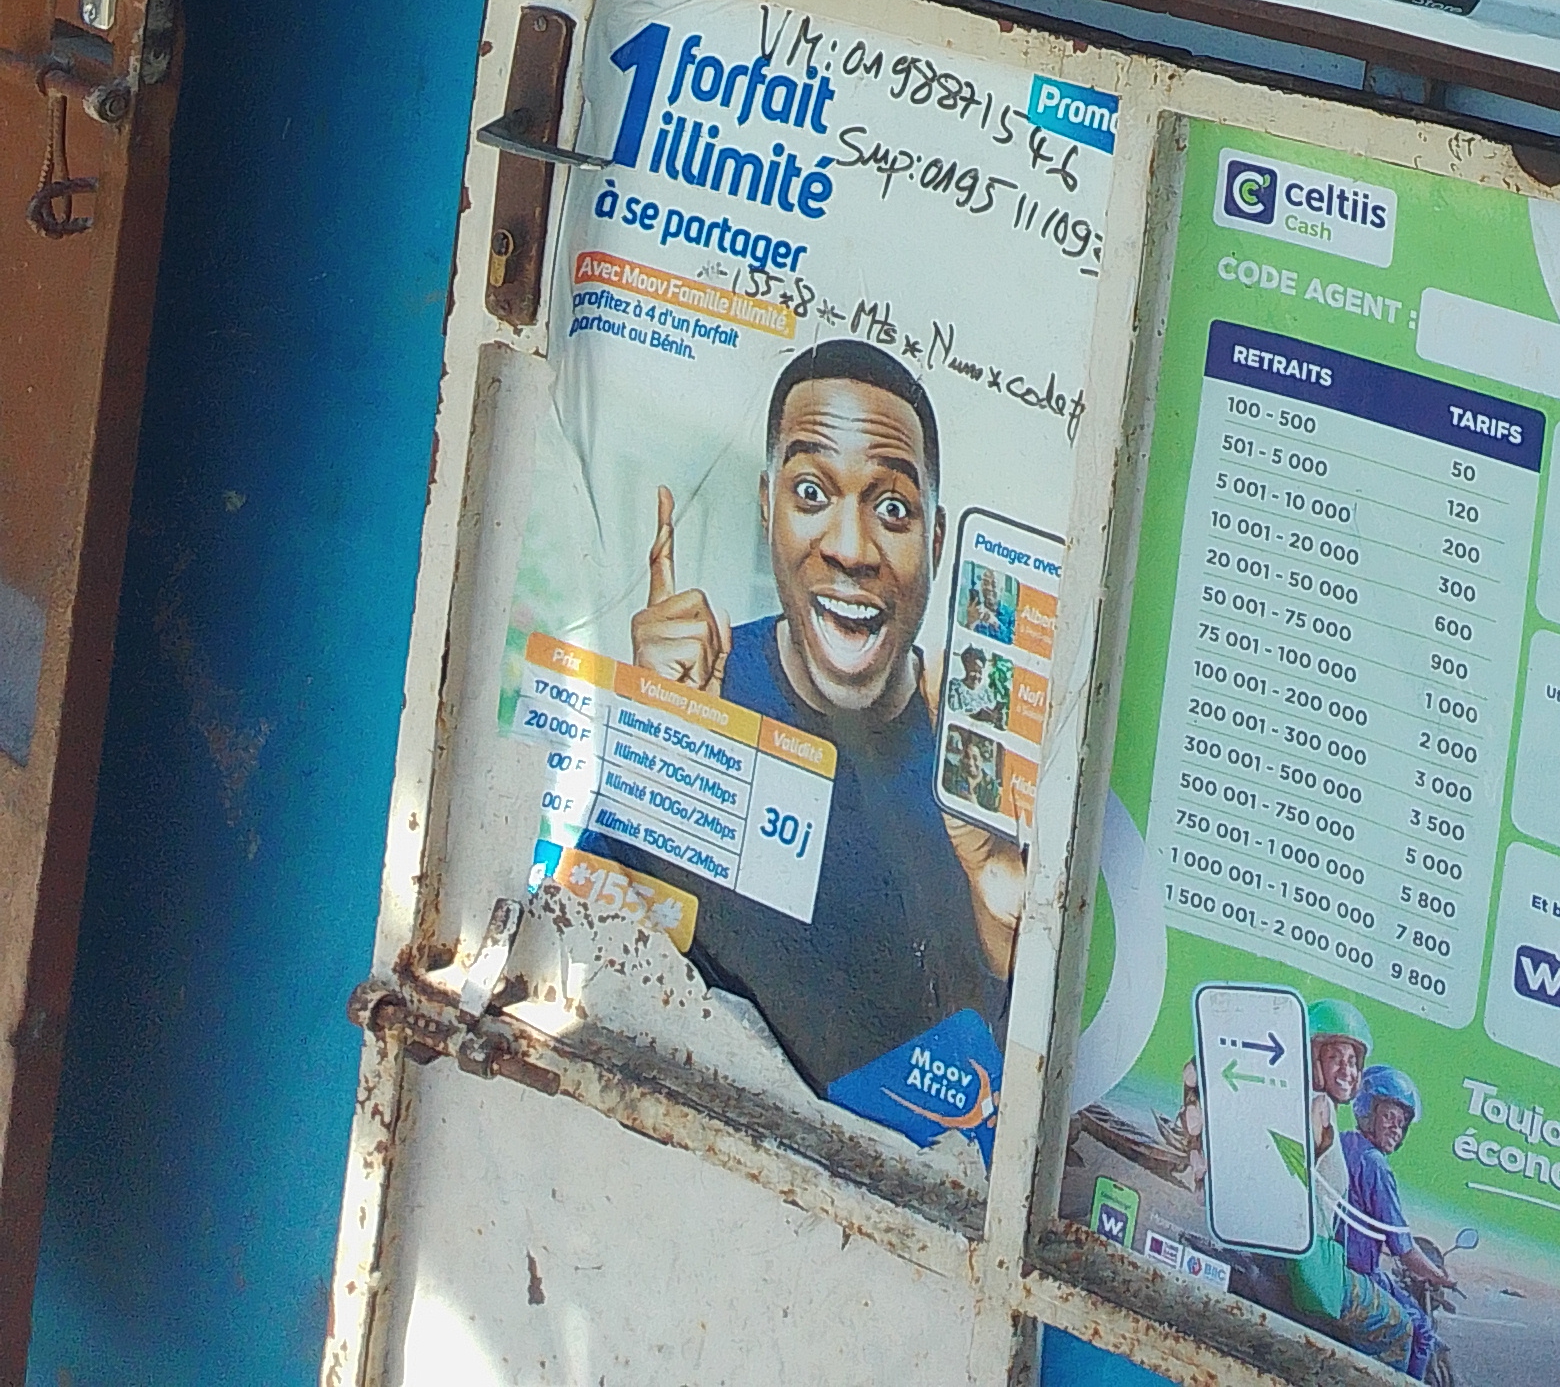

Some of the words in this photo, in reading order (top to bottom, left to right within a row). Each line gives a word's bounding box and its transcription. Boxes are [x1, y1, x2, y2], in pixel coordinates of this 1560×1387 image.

[610, 23, 670, 168] 1
[669, 34, 836, 135] forfait
[649, 111, 836, 220] illimité
[1284, 182, 1387, 229] celtiis
[595, 179, 617, 220] à
[623, 195, 656, 230] se
[660, 208, 807, 275] partager
[1285, 214, 1332, 241] Cash
[578, 257, 620, 282] Avec
[622, 266, 667, 294] Moov
[668, 278, 729, 312] Famille
[1217, 256, 1298, 295] CODE
[1304, 277, 1402, 323] AGENT
[569, 316, 626, 338] partout
[629, 329, 647, 344] au
[650, 329, 695, 359] Bénin.
[573, 290, 631, 314] profitez
[633, 300, 642, 318] à
[645, 305, 655, 321] 4
[658, 308, 690, 333] d'un
[691, 318, 739, 348] forfait
[1233, 344, 1332, 386] RETRAITS
[1449, 405, 1523, 444] TARIFS
[1227, 397, 1261, 419] 100
[1279, 411, 1316, 433] 500
[1221, 435, 1253, 457] 501
[1271, 448, 1283, 466] 5
[1288, 453, 1328, 477] 000
[1451, 461, 1476, 482] 50
[1447, 500, 1479, 523] 120
[974, 533, 1030, 567] Partagez
[1033, 557, 1062, 577] avec
[1442, 539, 1480, 564] 200
[1438, 577, 1476, 602] 300
[1435, 616, 1473, 641] 600
[1430, 654, 1468, 680] 900
[534, 680, 549, 694] 17
[550, 684, 578, 707] 000
[580, 696, 592, 710] F
[1438, 697, 1478, 724] 000
[524, 710, 548, 729] 20
[550, 717, 578, 738] 000
[580, 728, 592, 742] F
[618, 710, 661, 737] Illimité
[663, 725, 742, 773] 55Go/1Mbps
[640, 678, 686, 708] Volume
[688, 697, 729, 726] promo
[773, 730, 823, 765] Validité
[575, 759, 586, 770] F
[614, 741, 656, 770] Illimité
[658, 759, 738, 805] 70Go/1Mbps
[605, 771, 646, 799] Illimité
[648, 789, 737, 841] 100Go/2Mbps
[596, 808, 640, 839] Illimité
[643, 825, 730, 879] 150Go/2Mbps
[760, 807, 797, 845] 30
[796, 822, 812, 858] j
[1532, 894, 1548, 913] Et
[1412, 930, 1451, 958] 800
[1408, 969, 1446, 996] 800
[911, 1047, 972, 1087] Moov
[907, 1068, 966, 1109] Africa
